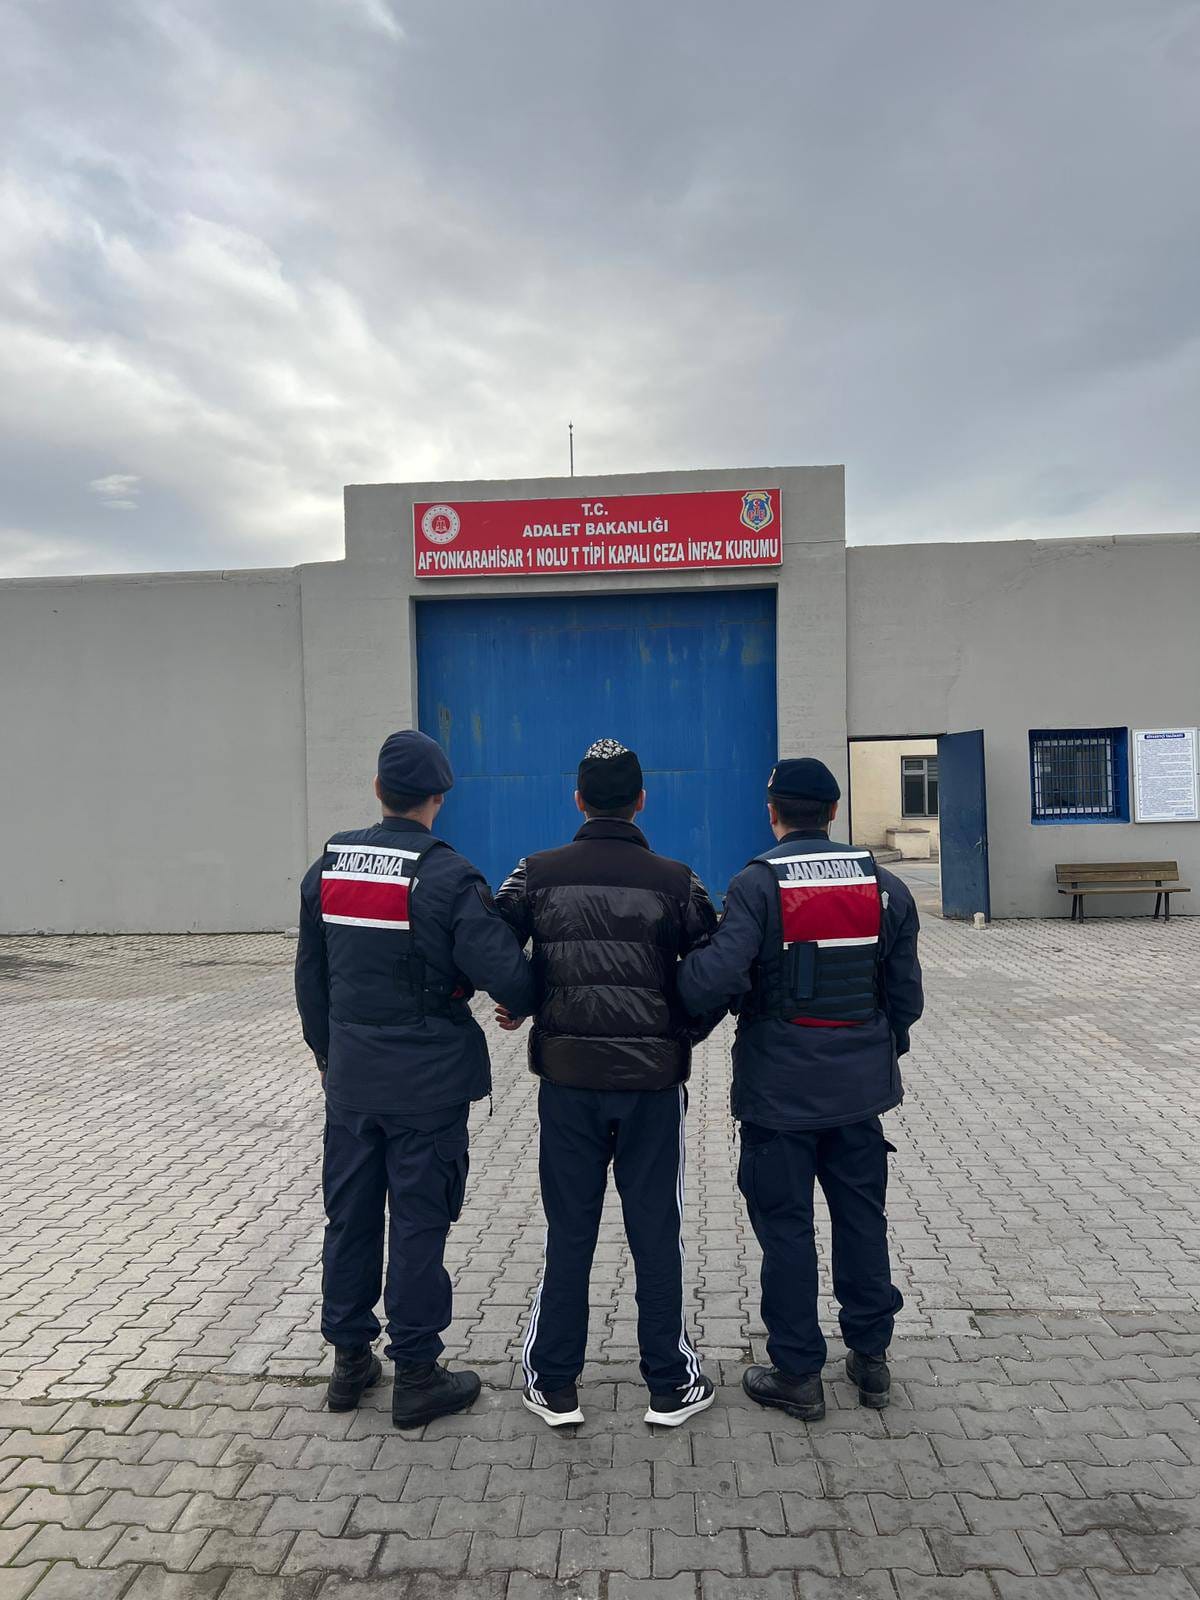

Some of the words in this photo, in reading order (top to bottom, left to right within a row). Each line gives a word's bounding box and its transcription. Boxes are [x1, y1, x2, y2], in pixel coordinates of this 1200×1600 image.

[581, 502, 609, 516] T.C.
[523, 523, 580, 537] ADALET
[585, 517, 669, 535] BAKANLIĞI
[418, 545, 523, 570] AFYONKARAHİSAR
[527, 549, 532, 566] 1
[536, 547, 568, 566] NOLU
[572, 547, 579, 566] T
[582, 541, 605, 565] TİPİ
[608, 544, 650, 564] KAPALI
[653, 543, 685, 562] CEZA
[688, 537, 722, 561] İNFAZ
[725, 538, 778, 559] KURUMU
[333, 853, 403, 876] JANDARMA
[786, 861, 865, 880] JANDARMA
